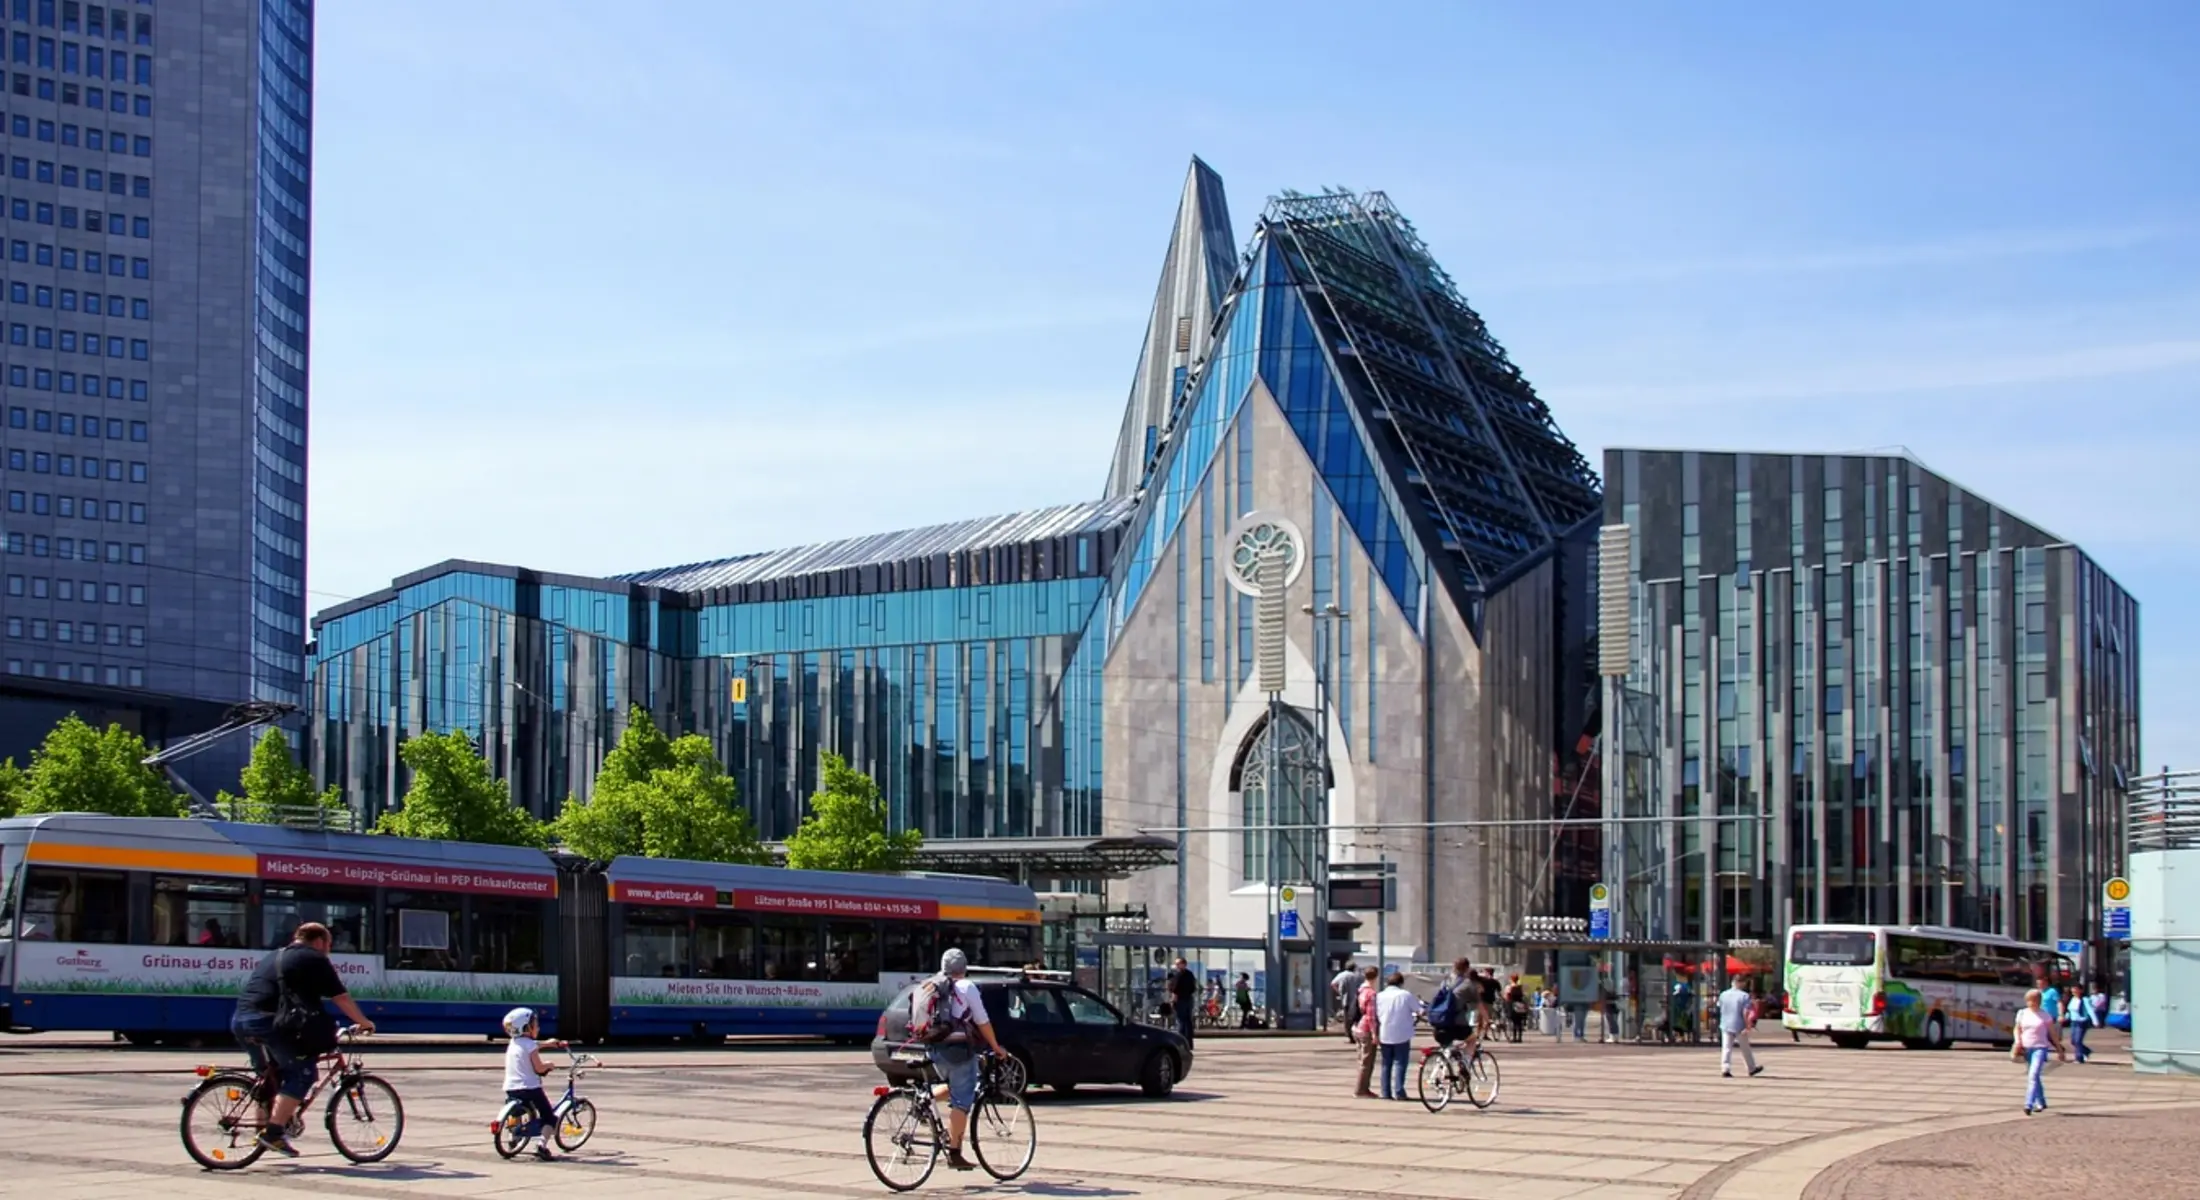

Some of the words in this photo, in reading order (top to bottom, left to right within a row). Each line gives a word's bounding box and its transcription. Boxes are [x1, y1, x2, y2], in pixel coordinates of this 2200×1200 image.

[267, 861, 329, 877] Miet-Shop
[345, 867, 431, 883] Leipzig-Grünau
[435, 873, 448, 884] im
[452, 875, 470, 885] PEP
[473, 876, 548, 891] Einkaufscenter
[627, 888, 704, 902] www.gutburg.de
[754, 894, 785, 906] Lützner
[787, 896, 812, 908] Straße
[834, 900, 861, 911] Telefon
[667, 983, 702, 995] Mieten
[705, 983, 720, 994] Sie
[723, 984, 743, 995] Ihre
[745, 984, 822, 997] Wunsch-Räume.
